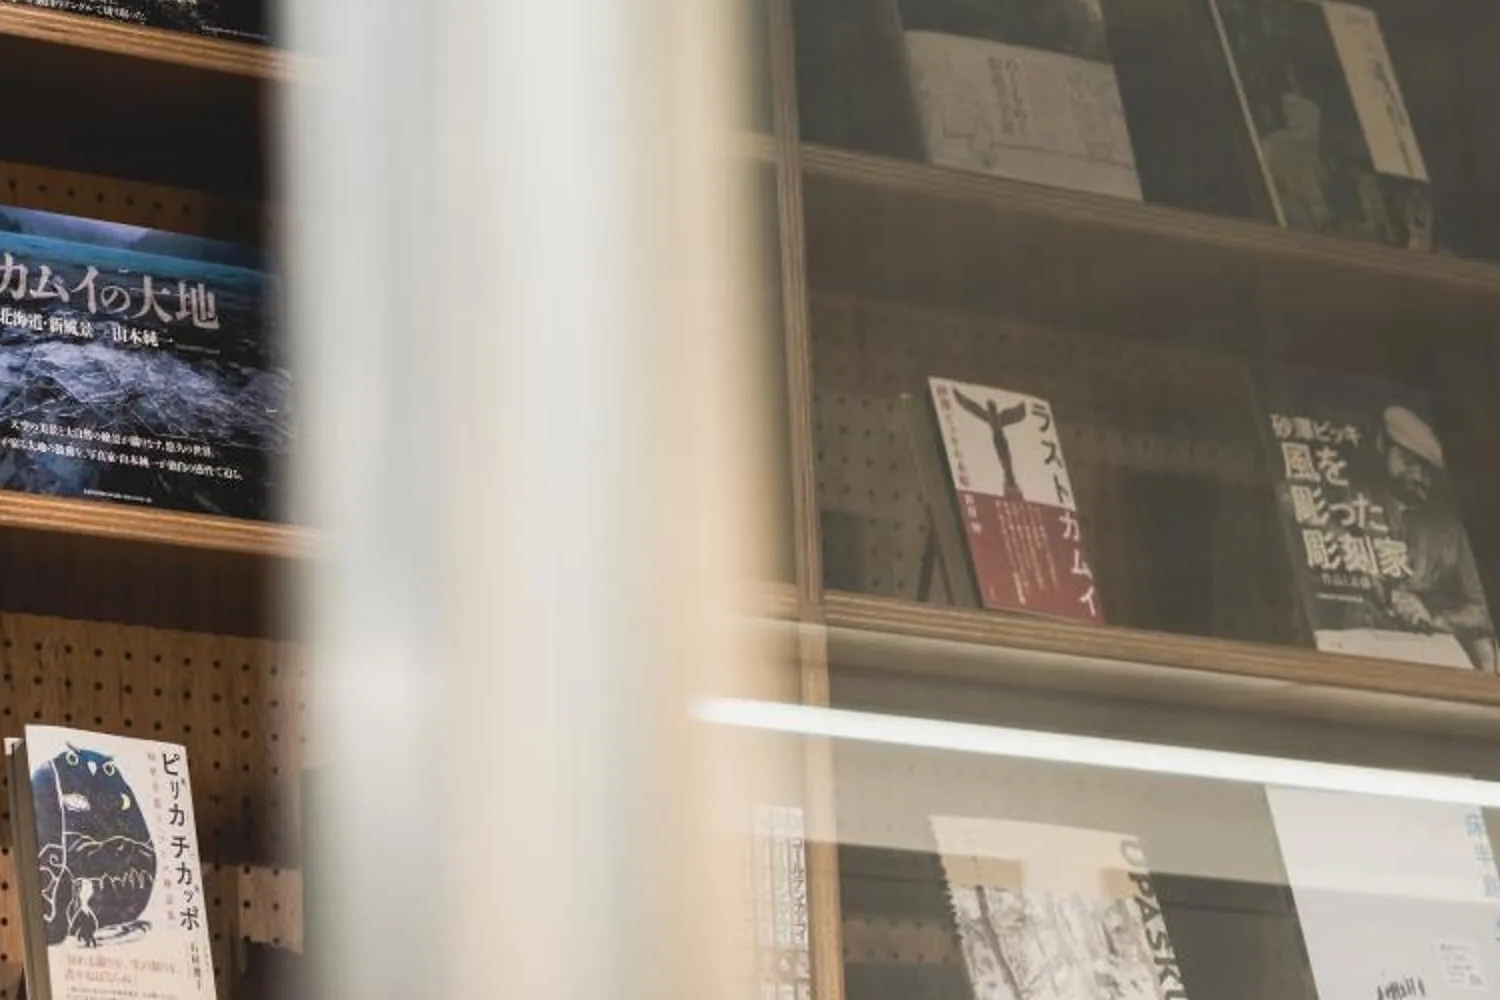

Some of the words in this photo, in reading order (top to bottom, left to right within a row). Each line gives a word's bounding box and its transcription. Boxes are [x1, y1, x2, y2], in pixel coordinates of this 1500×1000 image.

[1281, 440, 1349, 489] 風を
[1290, 484, 1389, 534] 彫った
[1302, 527, 1414, 579] 彫刻家
